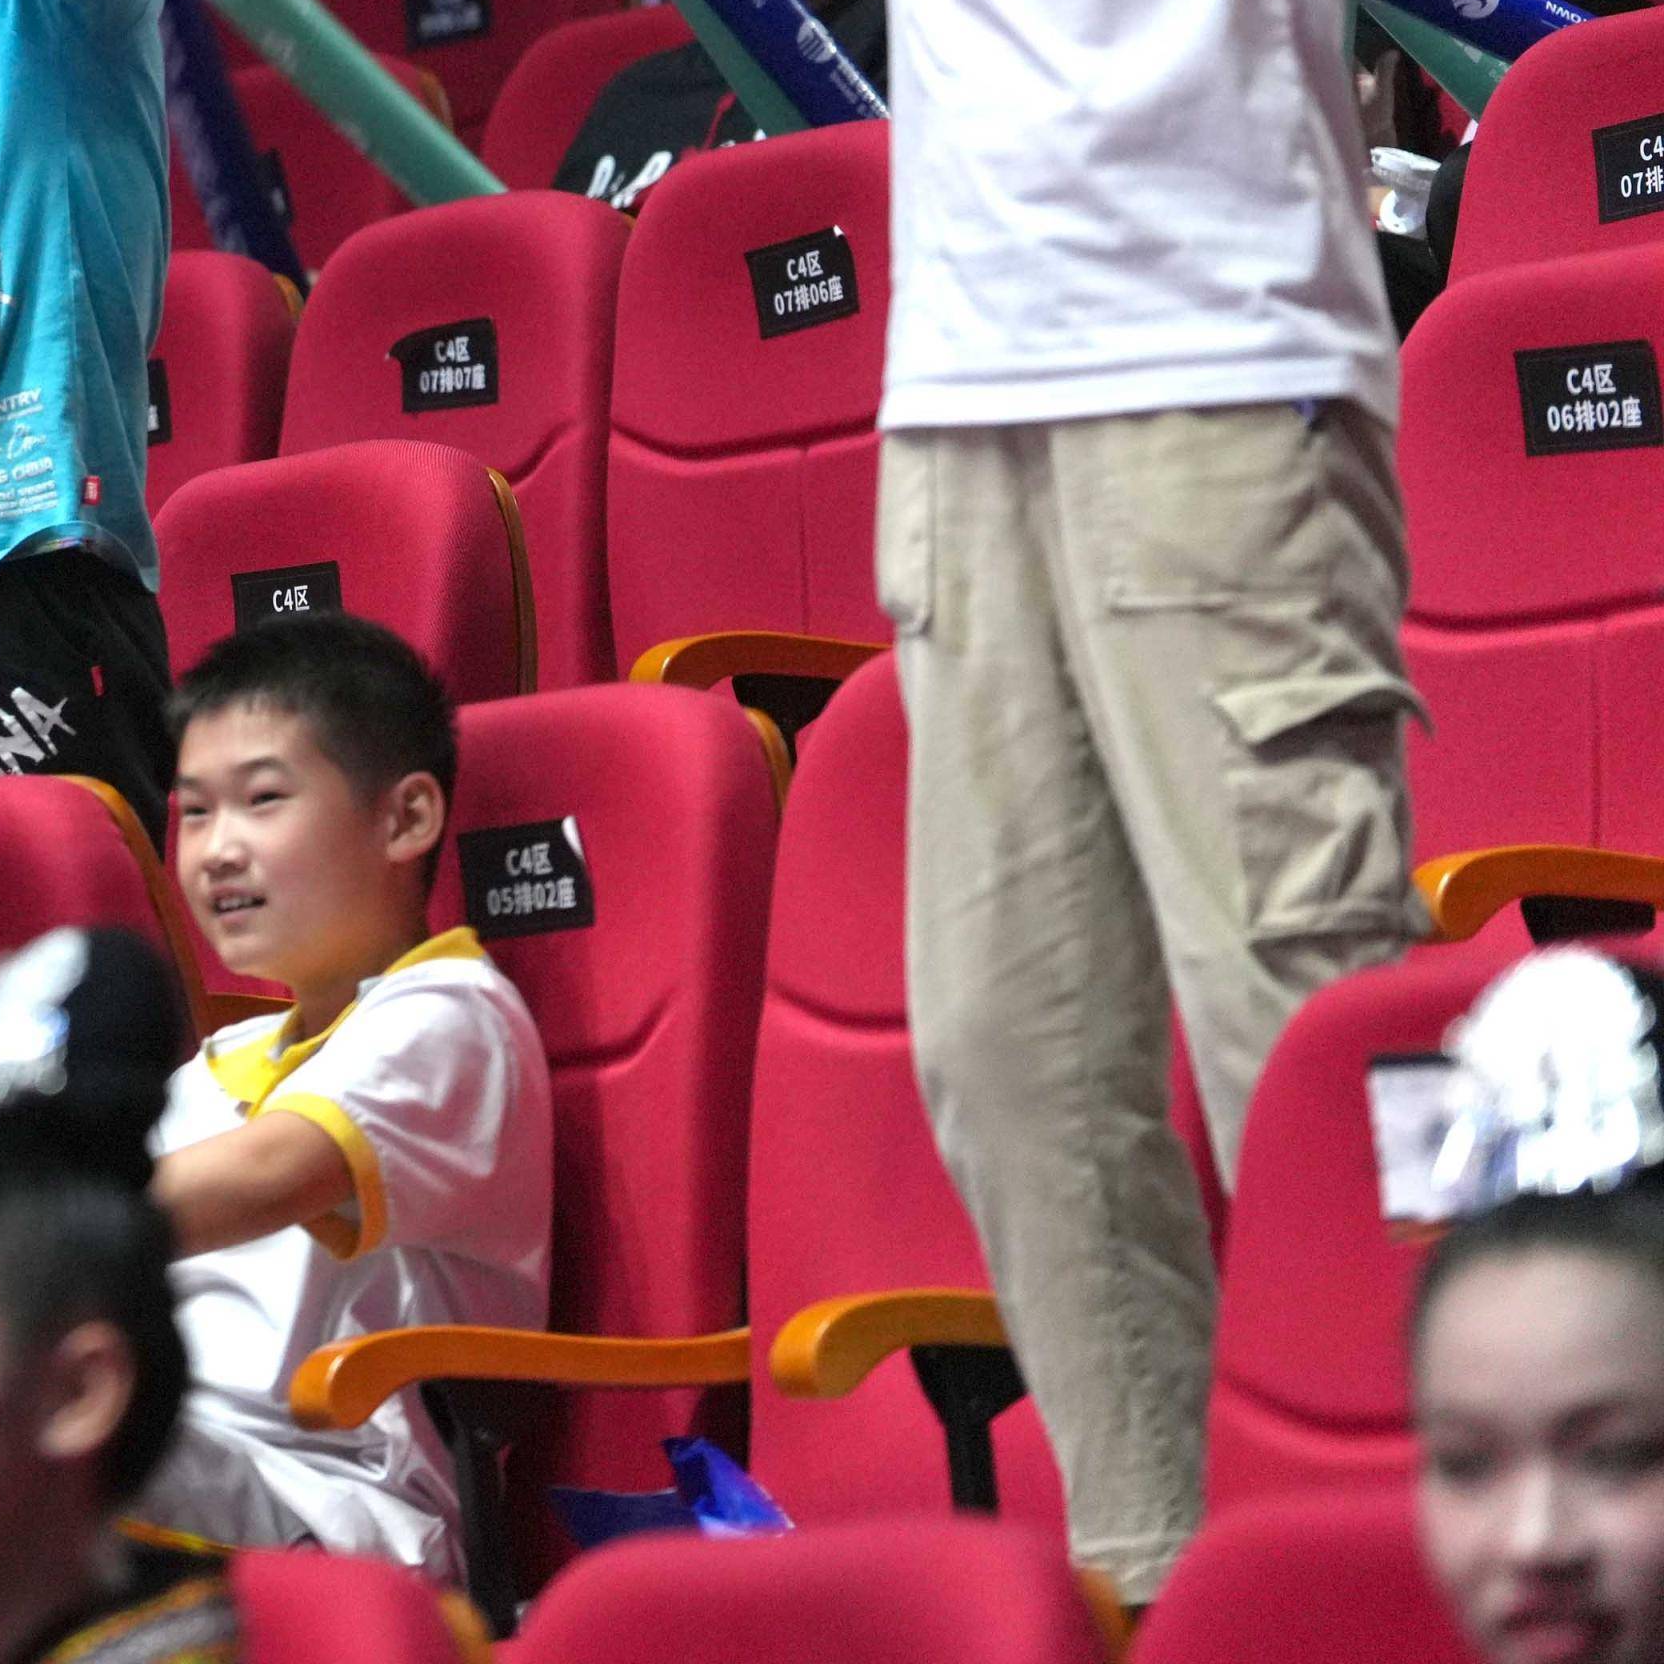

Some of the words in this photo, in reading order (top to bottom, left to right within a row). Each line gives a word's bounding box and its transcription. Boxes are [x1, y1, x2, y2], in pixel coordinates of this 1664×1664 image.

[787, 250, 824, 281] C4区
[774, 275, 845, 316] 07排06座
[434, 335, 471, 363] C4区
[419, 363, 486, 394] 07排07座
[1566, 363, 1617, 395] C4区
[1546, 395, 1643, 433] 06排02座
[273, 585, 311, 612] C4区
[504, 840, 554, 877] C4区
[486, 874, 577, 916] 05排02座
